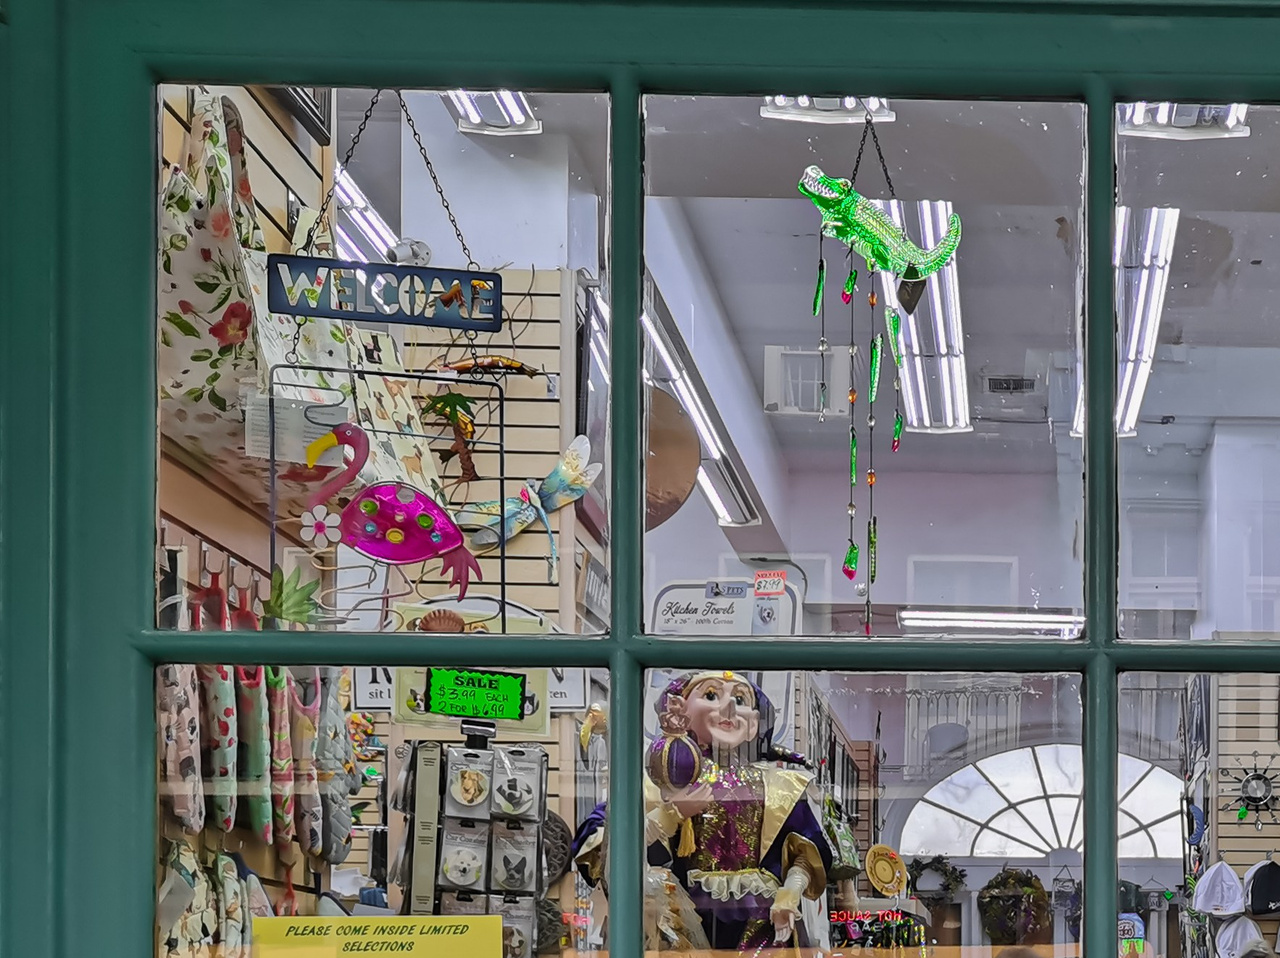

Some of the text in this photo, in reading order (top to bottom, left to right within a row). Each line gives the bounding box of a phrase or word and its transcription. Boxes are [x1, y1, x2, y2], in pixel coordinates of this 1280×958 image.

[276, 263, 495, 322] WELCOME
[756, 579, 781, 591] $7.99
[662, 601, 735, 616] Kitchen Towels
[455, 676, 498, 689] SALE
[438, 685, 509, 702] $3.99 EACH
[438, 702, 448, 713] 2
[450, 703, 467, 714] FOR
[285, 924, 469, 936] PLEASE COME INSIDE LIMITED
[342, 941, 415, 952] SELECTIONS
